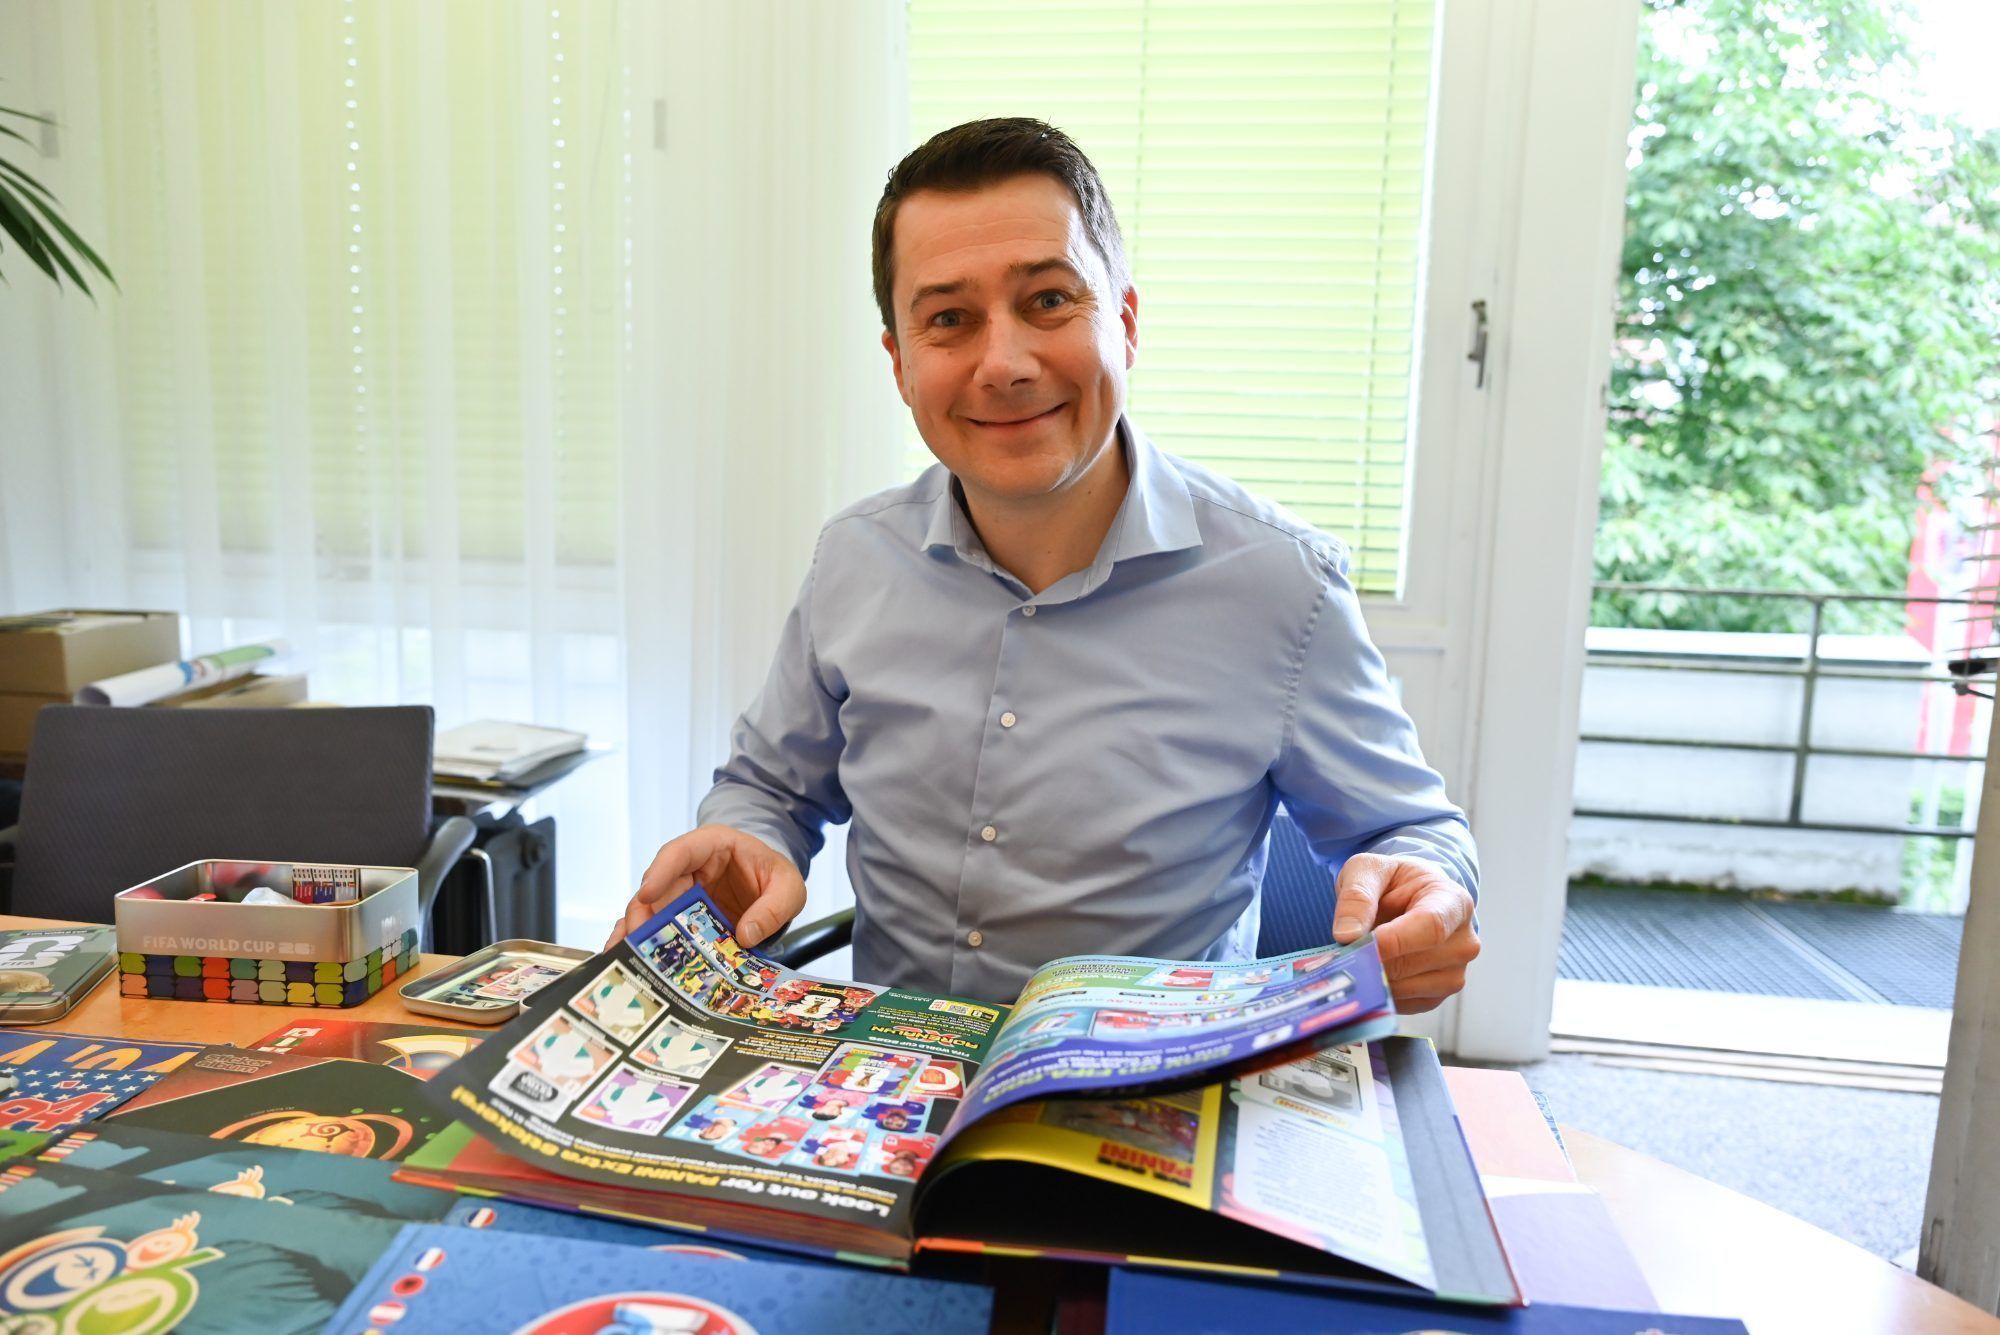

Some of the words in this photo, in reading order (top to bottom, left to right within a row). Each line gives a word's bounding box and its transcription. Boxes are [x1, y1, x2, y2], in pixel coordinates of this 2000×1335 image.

[143, 936, 178, 949] FIFA
[179, 937, 239, 952] WORLD
[243, 940, 275, 954] CUP
[870, 1025, 979, 1050] ADRENALYN
[918, 1044, 950, 1053] WORLD
[951, 1050, 970, 1058] FIFA
[194, 1060, 260, 1074] album
[204, 1053, 273, 1067] sticker
[450, 1085, 560, 1156] Stickers!
[561, 1149, 634, 1175] Extra
[1099, 1142, 1193, 1181] PANINI
[633, 1166, 720, 1187] PANINI
[720, 1178, 765, 1193] for
[767, 1183, 818, 1200] out
[820, 1192, 890, 1218] Look
